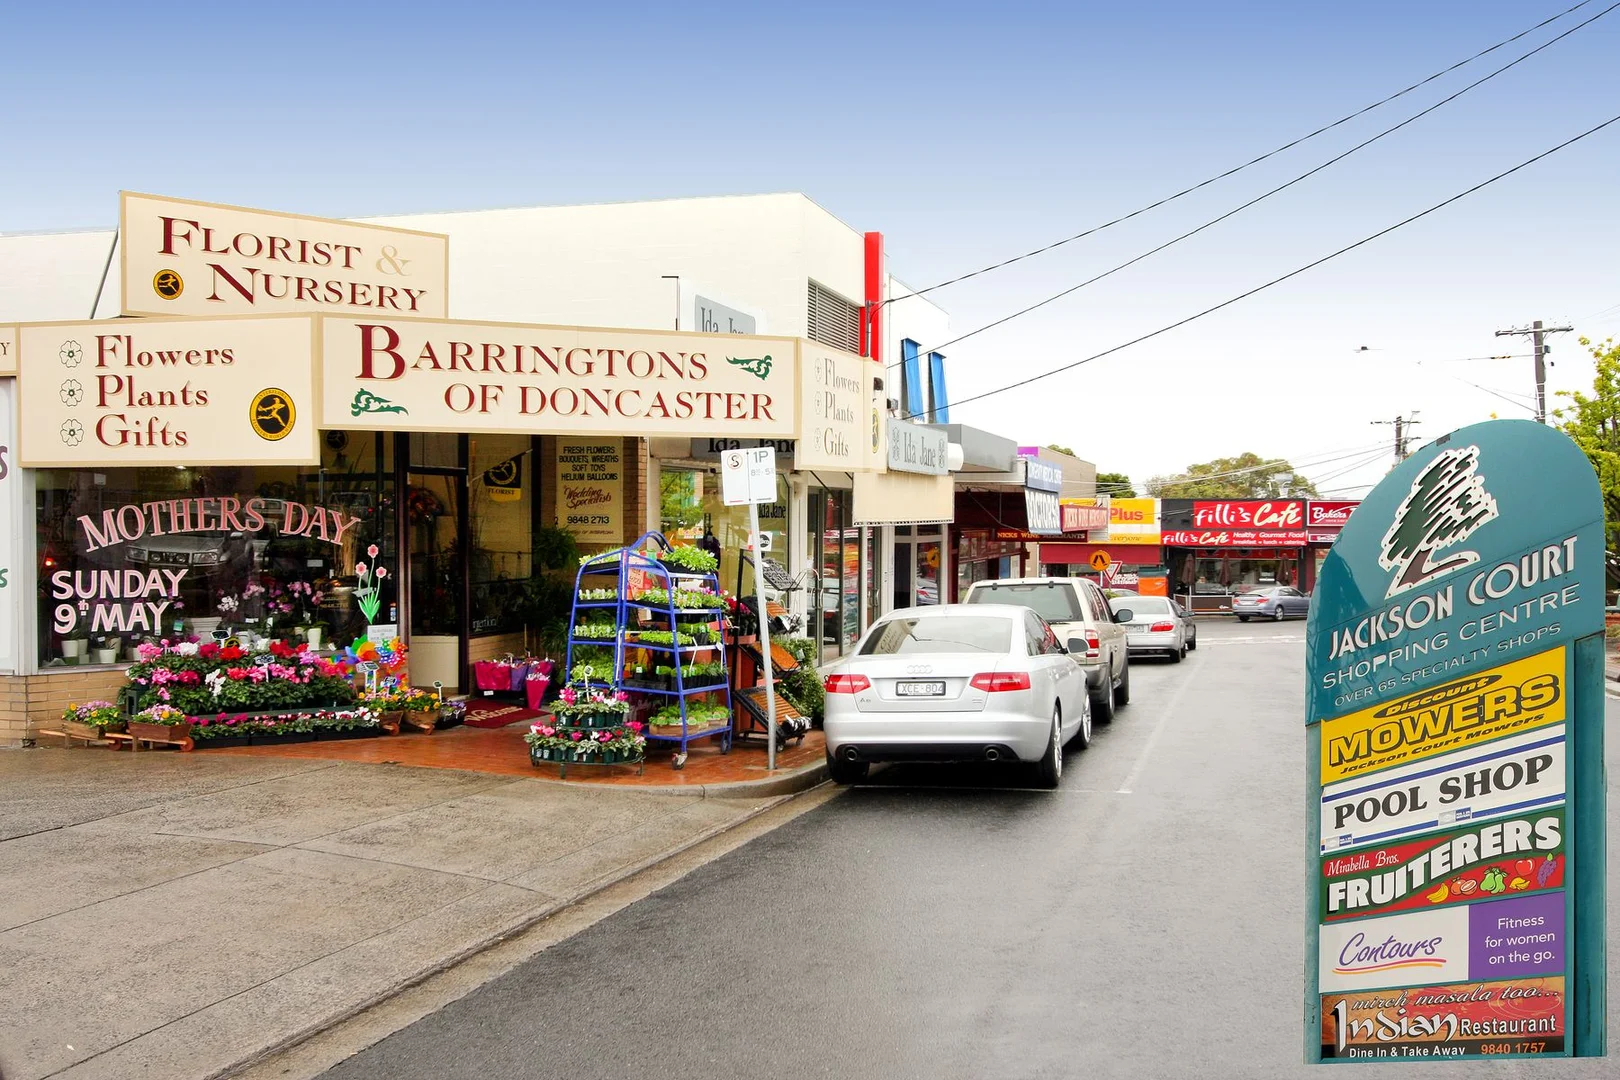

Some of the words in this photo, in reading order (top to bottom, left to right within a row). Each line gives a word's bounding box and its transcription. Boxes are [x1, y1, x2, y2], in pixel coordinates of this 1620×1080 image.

[158, 216, 362, 269] FLORIST
[375, 245, 411, 277] &
[206, 263, 427, 312] NURSERY
[94, 334, 235, 369] Flowers
[355, 324, 708, 381] BARRINGTONS
[95, 374, 210, 408] Plants
[824, 358, 860, 394] Flowers
[444, 383, 504, 415] OF
[518, 385, 775, 421] DONCASTER
[824, 391, 854, 424] Plants
[95, 413, 188, 448] Gifts
[708, 438, 740, 453] Ida
[824, 427, 849, 457] Gifts
[563, 446, 585, 454] FRESH
[586, 446, 616, 454] FLOWERS
[592, 455, 619, 463] WREATHS
[753, 450, 769, 463] 1P
[904, 432, 917, 463] Ida
[919, 436, 936, 468] Jane
[561, 473, 585, 481] HELIUM
[587, 473, 618, 481] BALLOONS
[572, 464, 588, 472] SOFT
[590, 464, 606, 472] TOYS
[563, 485, 603, 500] Wedding
[76, 497, 266, 553] MOTHERS
[279, 501, 361, 546] DAY
[567, 516, 590, 524] 9848
[591, 516, 610, 525] 2713
[1110, 507, 1144, 521] Plus
[1312, 507, 1347, 519] Bakers
[1233, 532, 1256, 540] Healthy
[51, 568, 189, 600] SUNDAY
[1327, 585, 1453, 662] JACKSON
[1467, 534, 1578, 606] COURT
[91, 601, 171, 633] MAY
[1323, 630, 1449, 690] SHOPPING
[1458, 582, 1581, 641] CENTRE
[1334, 685, 1374, 706] OVER
[1378, 677, 1396, 691] 65
[1401, 644, 1490, 686] SPECIALTY
[1497, 622, 1562, 653] SHOPS
[1386, 678, 1490, 717] Discount
[1329, 674, 1561, 767] MOWERS
[1340, 751, 1407, 775] Jackson
[1465, 713, 1545, 740] Mowers
[1334, 786, 1428, 829] POOL
[1438, 754, 1554, 805] SHOP
[1328, 858, 1370, 877] Mirabella
[1375, 850, 1400, 868] Bros.
[1328, 817, 1562, 912] FRUITERERS
[1497, 916, 1545, 930] Fitness
[1339, 932, 1443, 966] Contours
[1484, 936, 1502, 949] for
[1506, 932, 1556, 946] women
[1488, 955, 1505, 965] on
[1507, 952, 1529, 963] the
[1533, 950, 1556, 964] go.
[1351, 991, 1408, 1011] mirch
[1414, 984, 1493, 1006] masala
[1334, 999, 1459, 1053] Indian
[1461, 1014, 1556, 1037] Restaurant
[1349, 1048, 1374, 1058] Dine
[1376, 1047, 1388, 1058] In
[1391, 1047, 1398, 1058] &
[1401, 1045, 1429, 1056] Take
[1481, 1043, 1511, 1055] 9840
[1515, 1042, 1546, 1054] 1757
